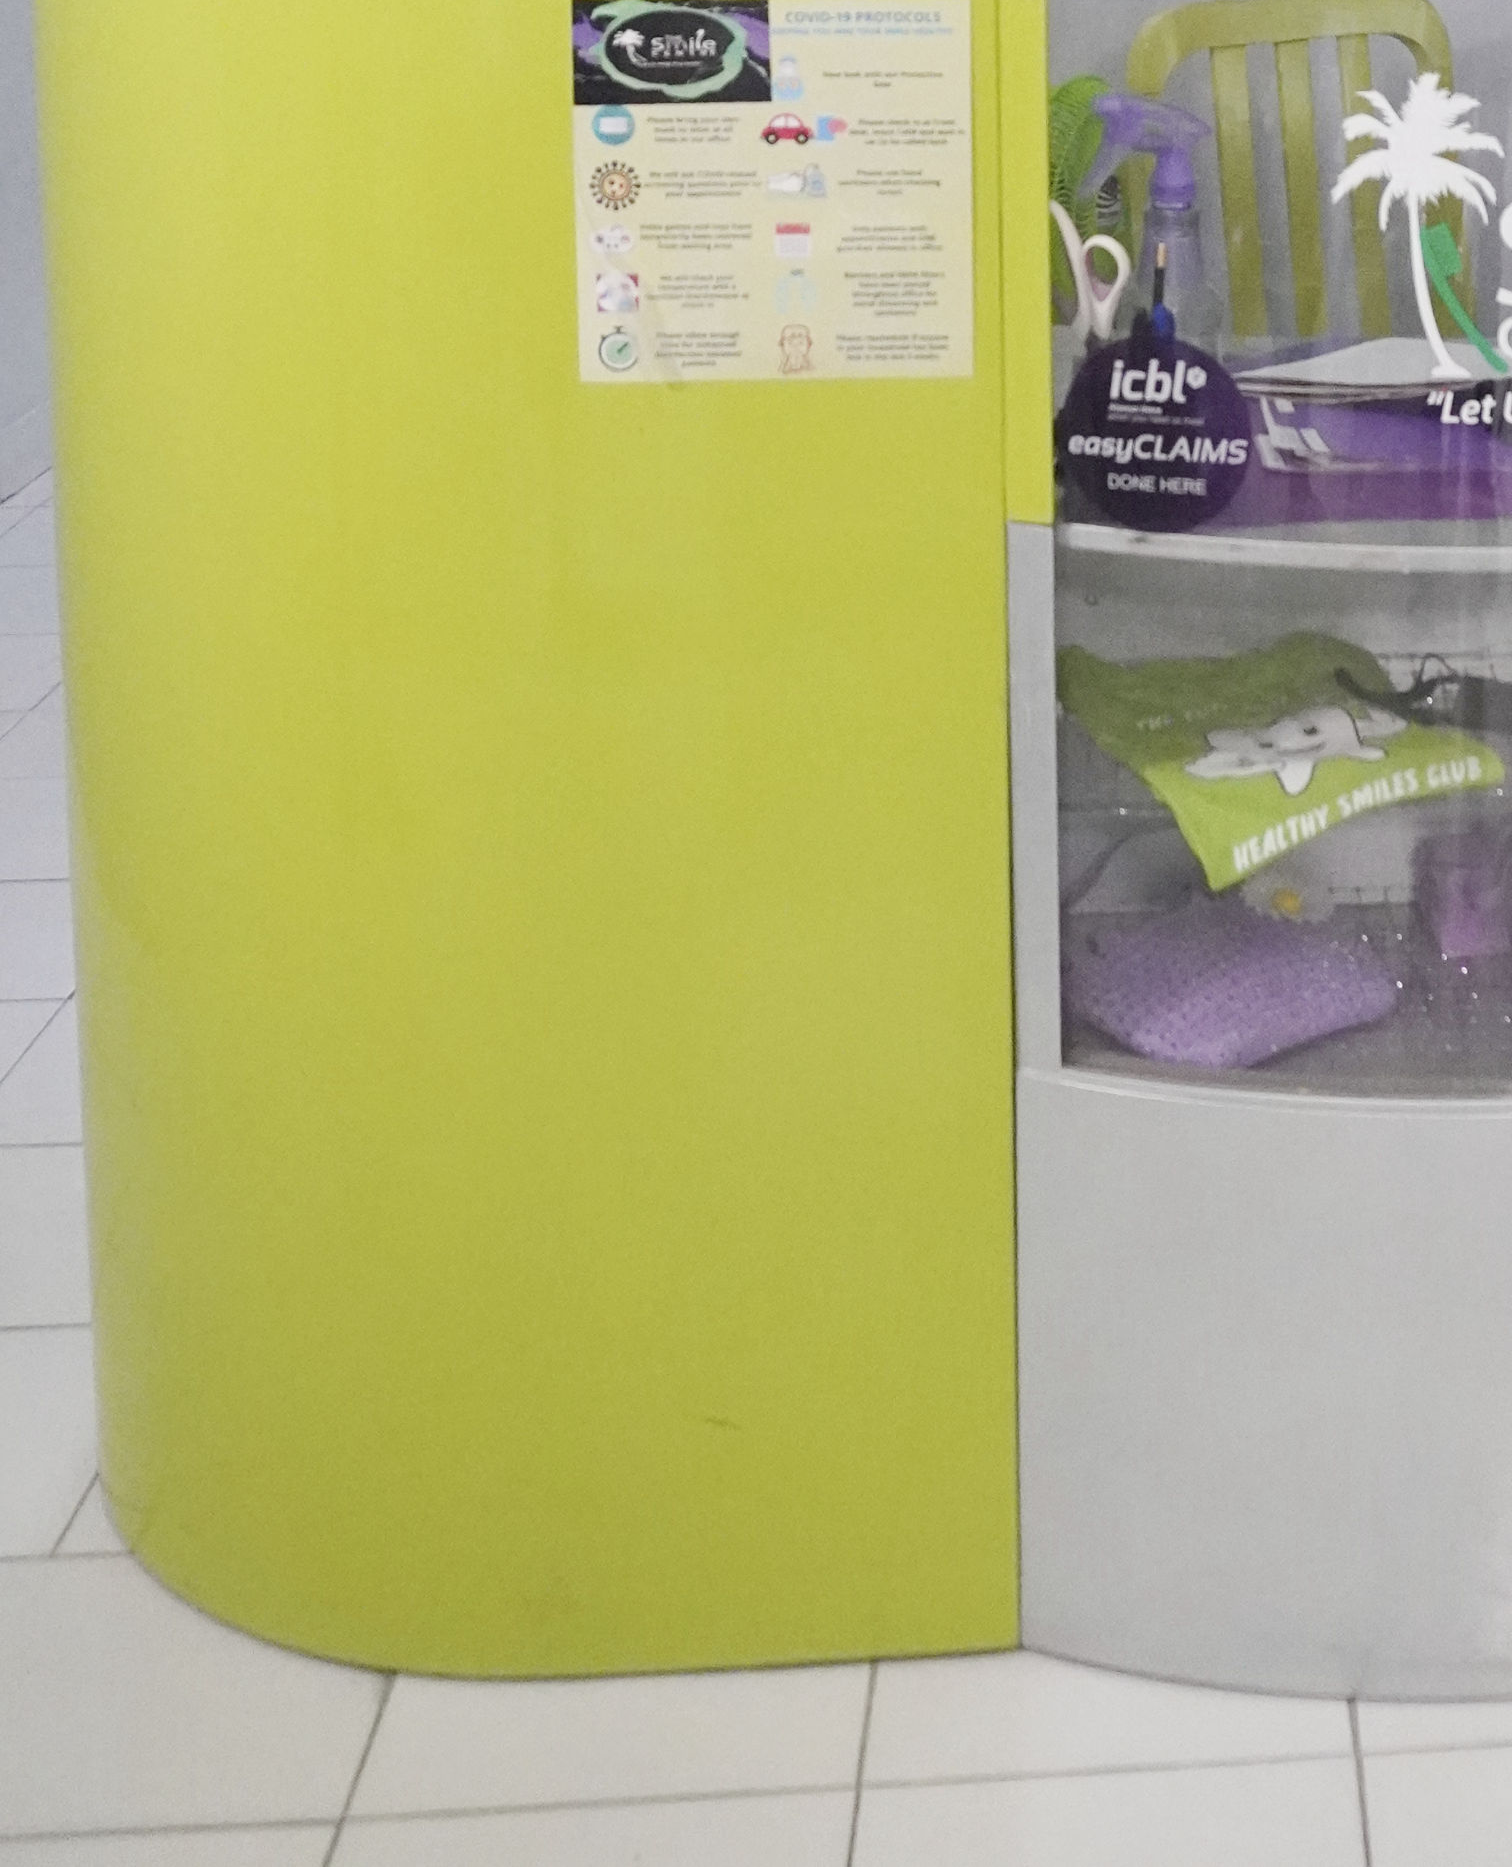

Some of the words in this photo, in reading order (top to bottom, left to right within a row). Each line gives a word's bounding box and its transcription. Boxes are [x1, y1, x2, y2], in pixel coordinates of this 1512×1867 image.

[1109, 359, 1187, 404] icbl
[1068, 433, 1249, 465] easyCLAIMS
[1107, 472, 1155, 493] DONE
[1160, 476, 1206, 496] HERE
[1233, 804, 1329, 874] HEALTHY
[1337, 768, 1419, 817] SMILES
[1426, 756, 1482, 788] CLUB
